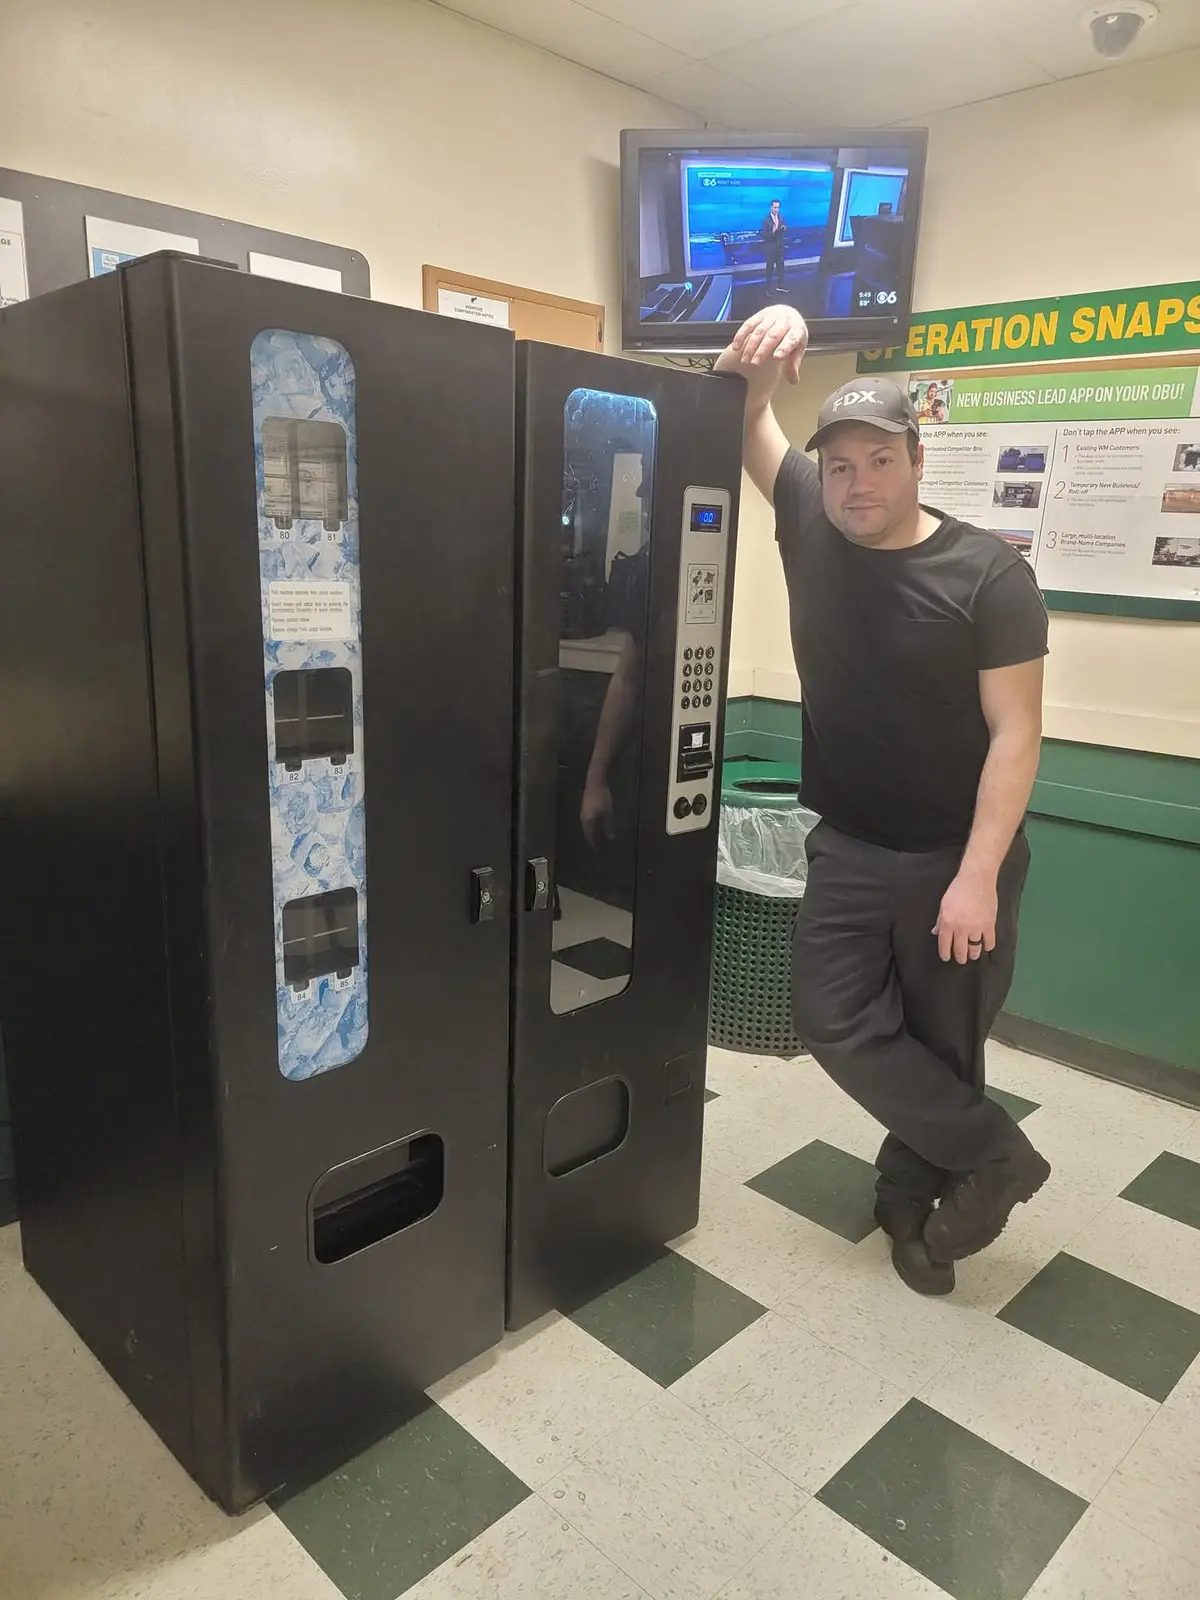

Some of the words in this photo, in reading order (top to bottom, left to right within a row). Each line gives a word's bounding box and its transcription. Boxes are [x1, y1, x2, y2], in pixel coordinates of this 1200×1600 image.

[864, 310, 1060, 361] ERATION
[1070, 295, 1200, 344] SNAPS
[956, 391, 983, 408] NEW
[983, 389, 1036, 406] BUSINESS
[1037, 387, 1067, 405] LEAD
[1069, 387, 1095, 404] APP
[1095, 386, 1114, 402] ON
[1115, 384, 1150, 401] YOUR
[1151, 383, 1185, 400] OBU!
[832, 390, 877, 412] FDX
[1063, 428, 1082, 436] Don't
[1083, 429, 1096, 438] tap
[1096, 428, 1108, 436] the
[1109, 427, 1126, 435] APP
[1126, 427, 1147, 435] when
[1147, 428, 1162, 436] you
[947, 445, 972, 453] Competitor
[1062, 444, 1069, 463] 1
[1053, 480, 1066, 499] 2
[1070, 481, 1099, 489] Temporary
[280, 531, 290, 540] 80
[327, 532, 336, 541] 81
[1045, 530, 1058, 549] 3
[1061, 531, 1078, 539] Large,
[1078, 532, 1116, 540] multi-location
[1094, 540, 1126, 549] Companies
[333, 766, 344, 775] 83
[288, 772, 299, 781] 82
[340, 979, 349, 988] 85
[297, 991, 306, 1001] 84
